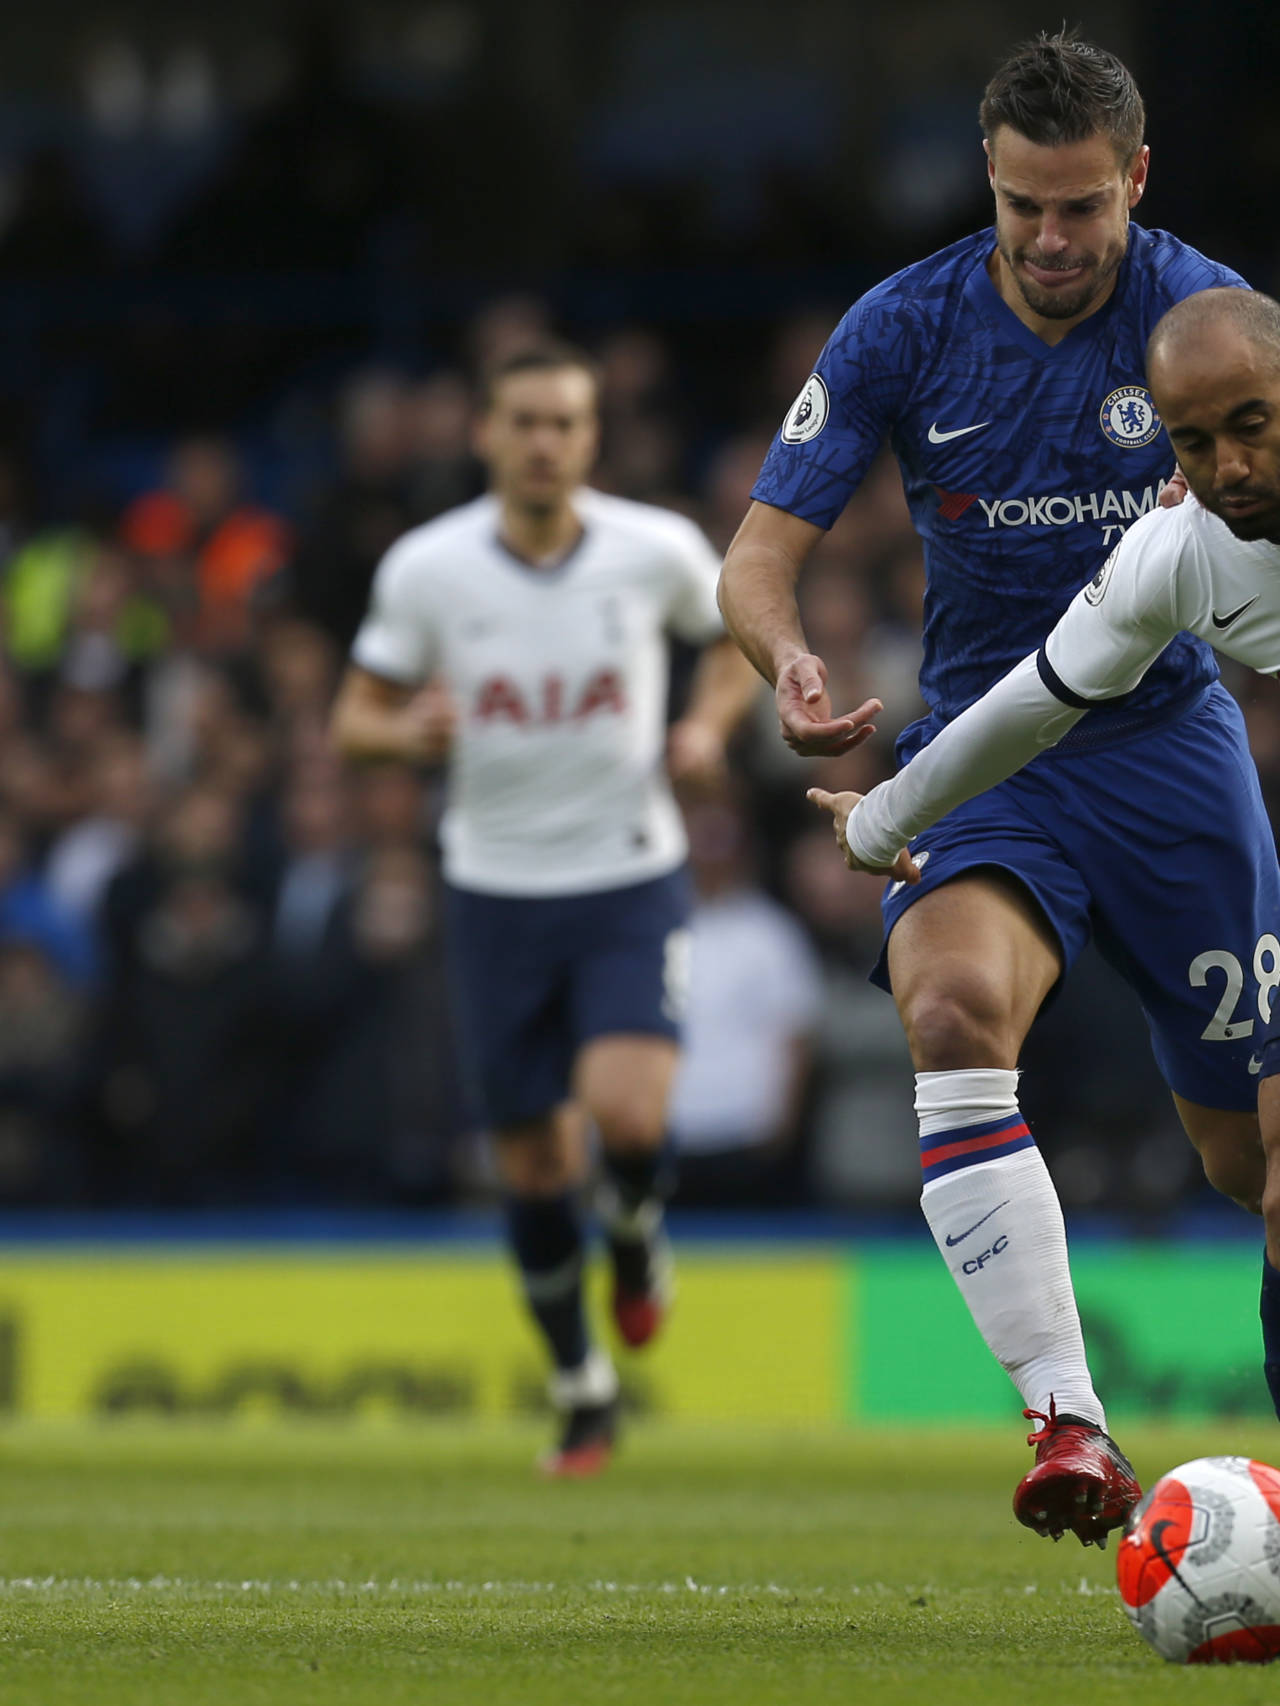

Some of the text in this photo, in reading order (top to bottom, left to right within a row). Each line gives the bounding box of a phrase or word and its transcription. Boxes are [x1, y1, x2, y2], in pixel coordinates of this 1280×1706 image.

[1107, 388, 1146, 406] CHELSEA
[474, 668, 630, 727] AIA
[962, 1235, 1010, 1275] CFC
